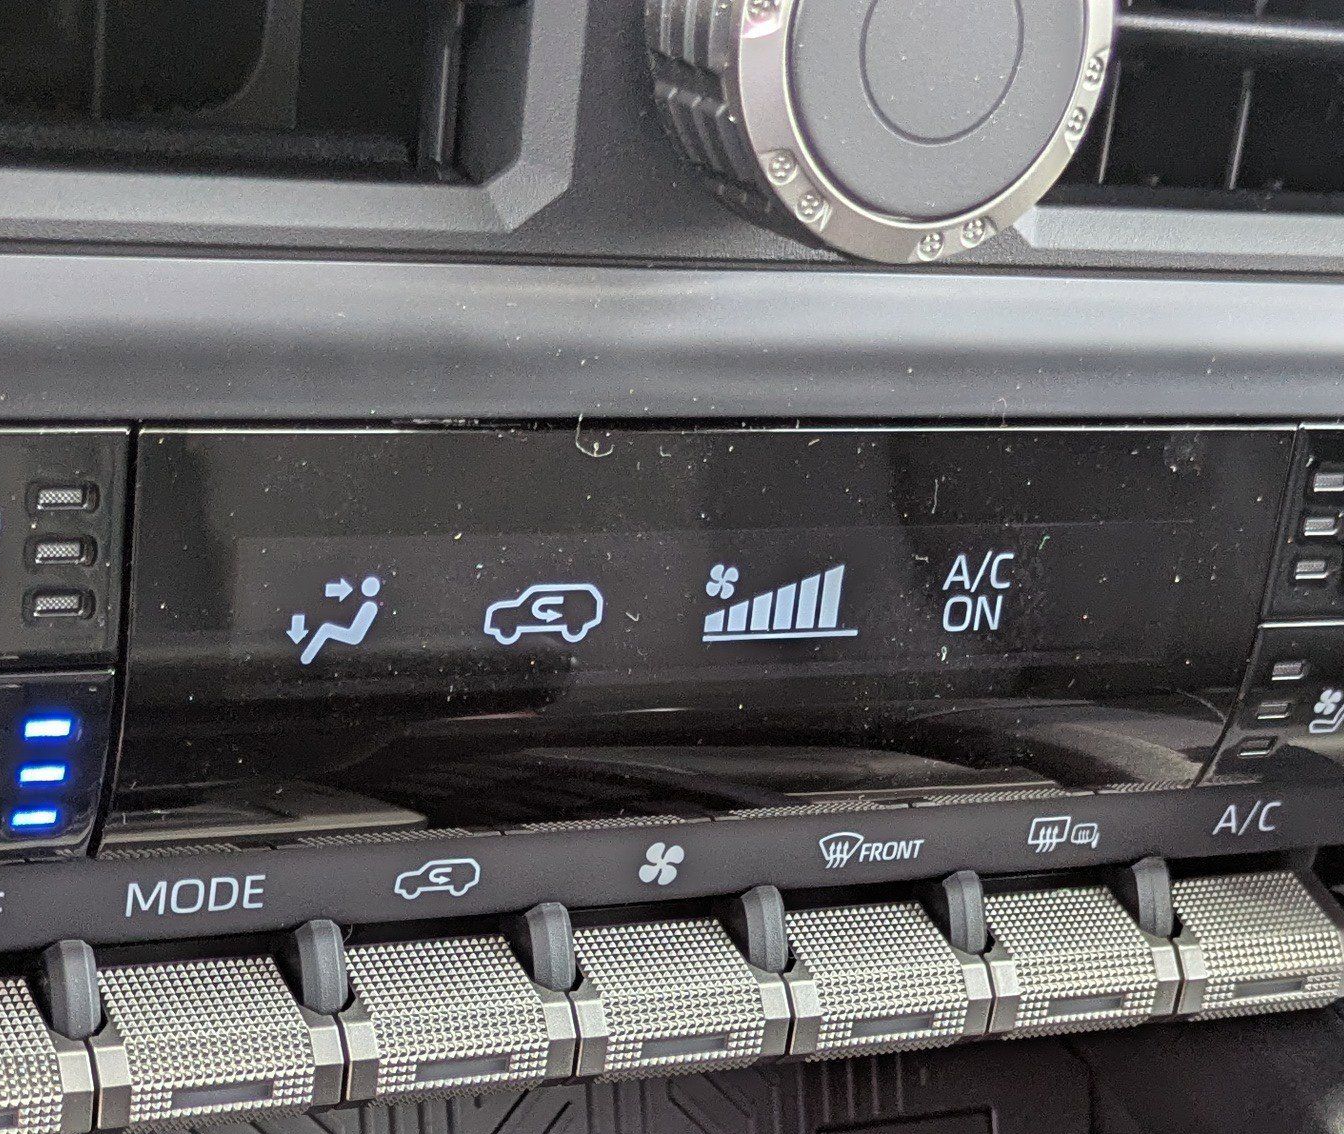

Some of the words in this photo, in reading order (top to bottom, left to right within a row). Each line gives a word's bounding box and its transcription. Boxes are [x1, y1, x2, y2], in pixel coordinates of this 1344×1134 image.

[942, 551, 1015, 592] A/C
[942, 594, 1003, 633] ON
[1212, 800, 1282, 837] A/C
[858, 838, 925, 865] FRONT
[125, 874, 267, 918] MODE
